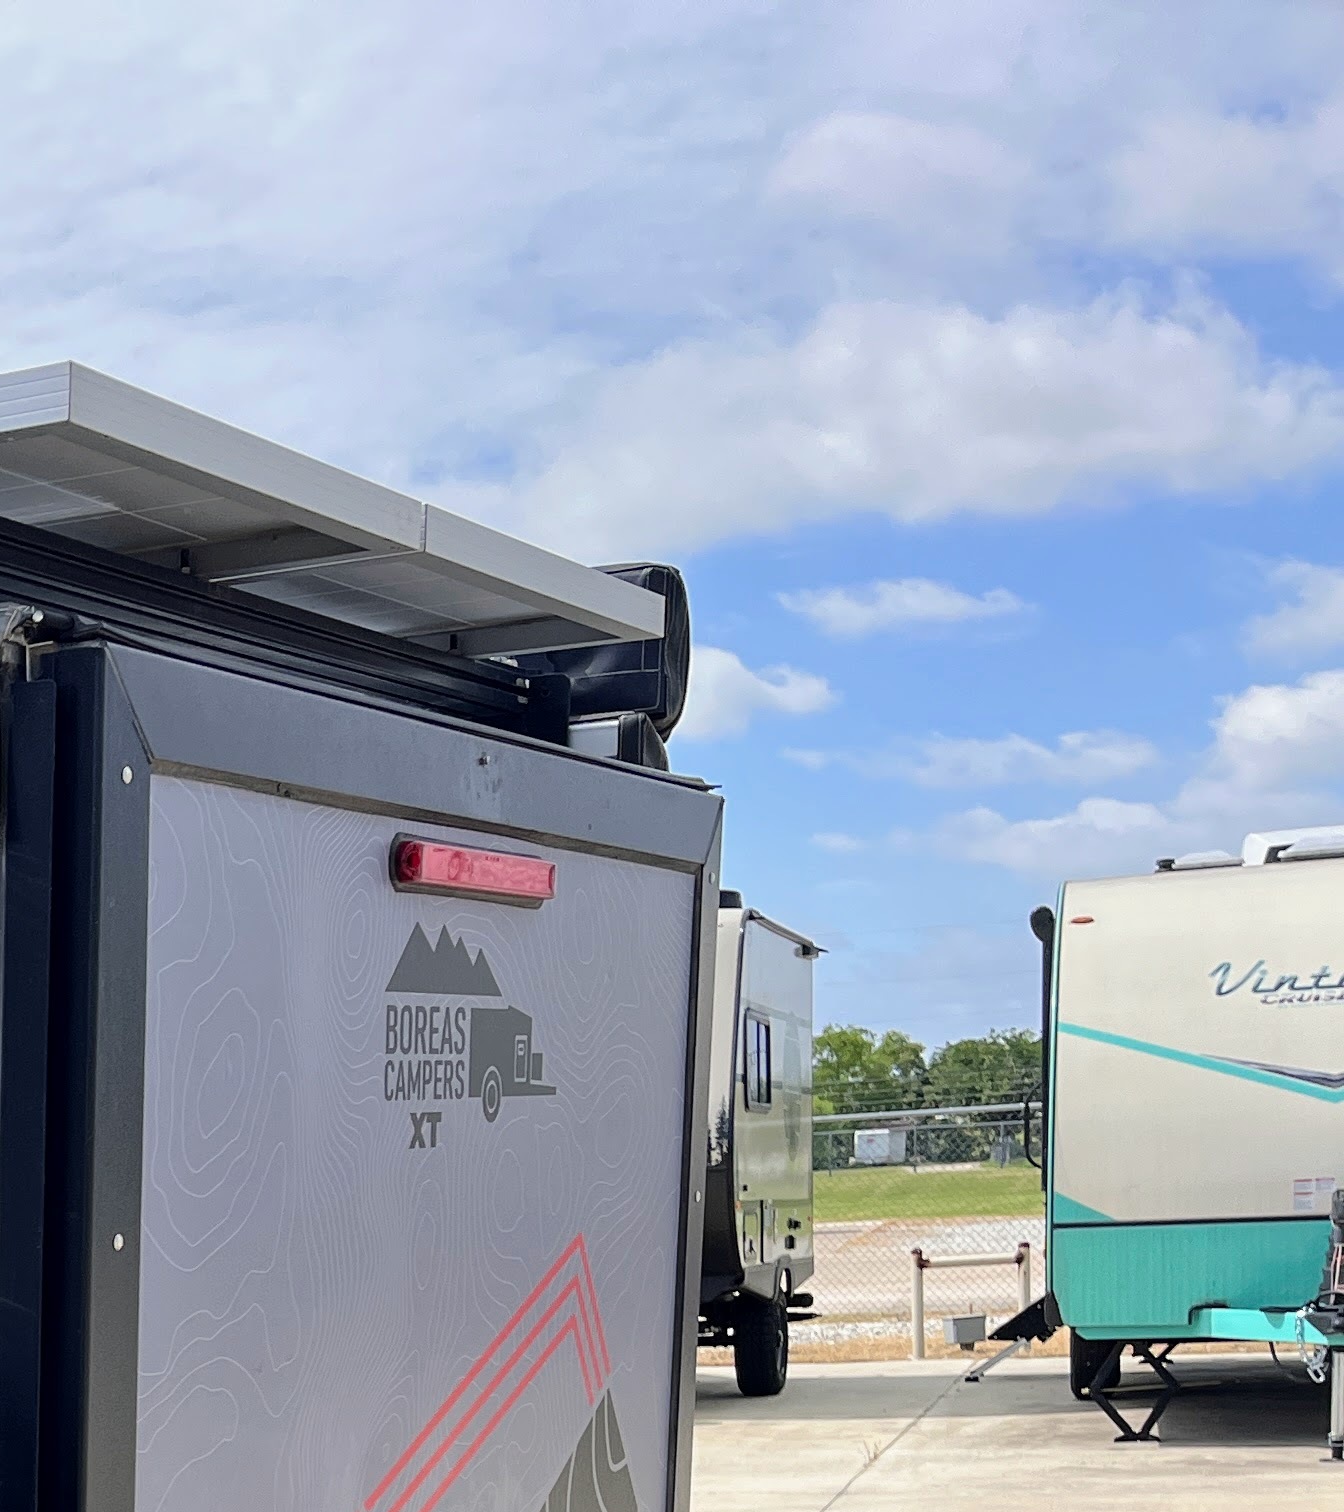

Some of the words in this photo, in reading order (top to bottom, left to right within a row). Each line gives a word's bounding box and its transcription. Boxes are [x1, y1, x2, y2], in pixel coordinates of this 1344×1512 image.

[1208, 959, 1344, 996] Vint
[385, 1004, 467, 1055] BOREAS
[383, 1059, 466, 1101] CAMPERS
[408, 1111, 443, 1150] XT
